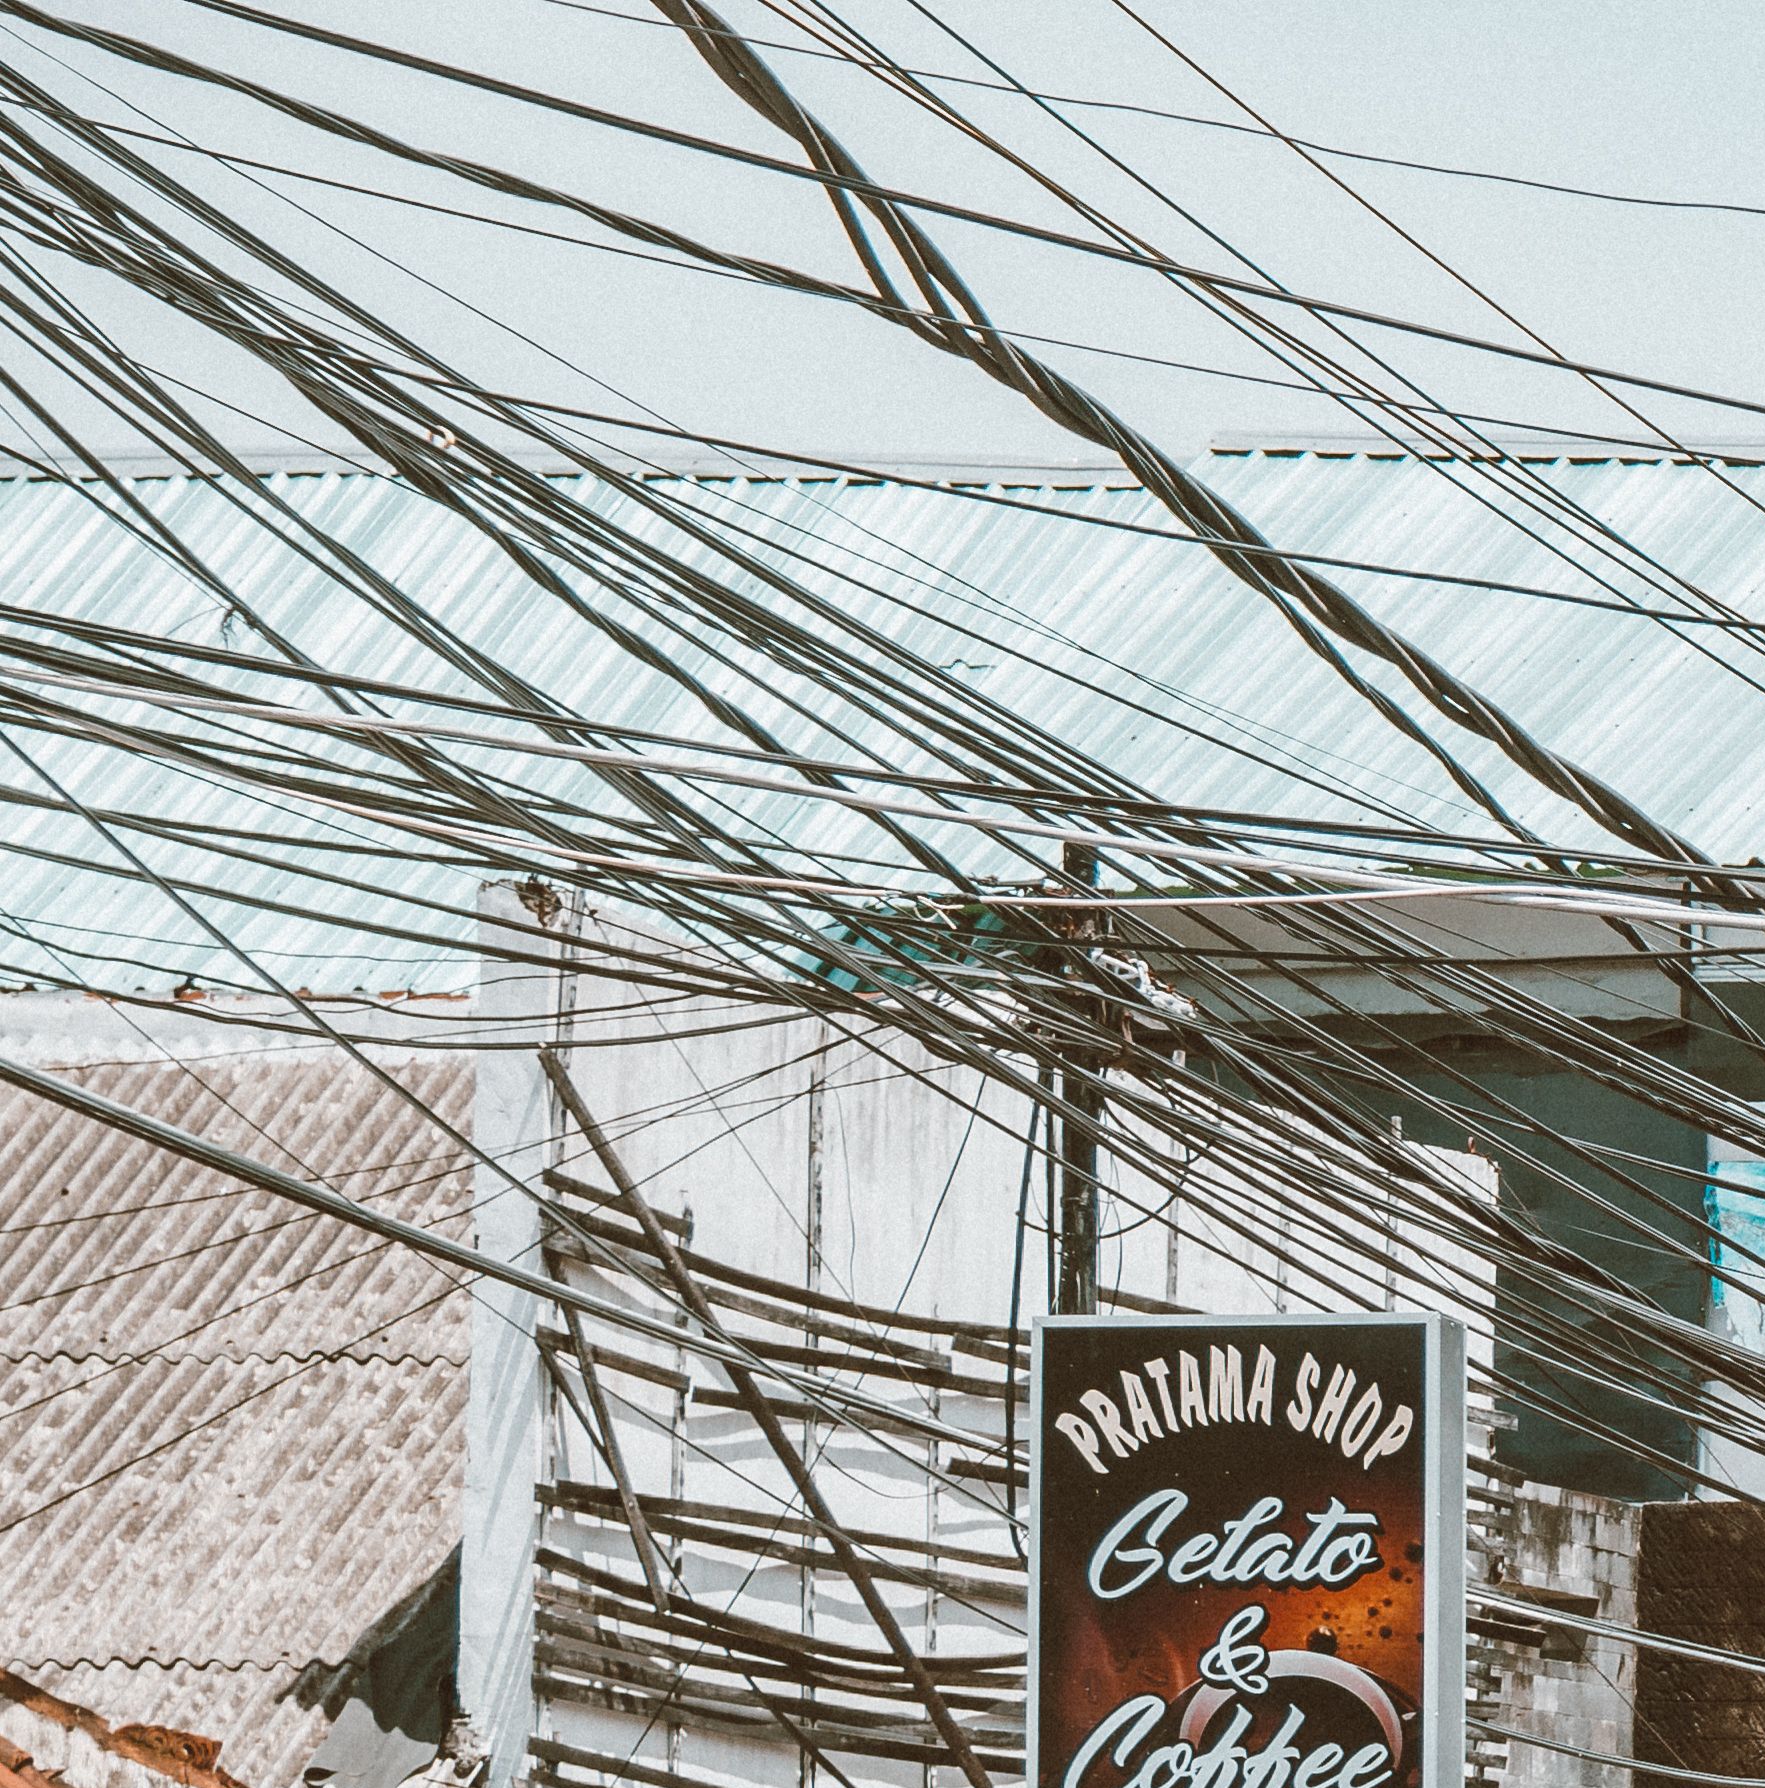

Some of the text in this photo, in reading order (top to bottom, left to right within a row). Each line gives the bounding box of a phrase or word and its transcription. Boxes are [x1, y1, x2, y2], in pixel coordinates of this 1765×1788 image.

[1055, 1344, 1414, 1473] PRATAMA SHOP
[1089, 1488, 1379, 1600] Gelato
[1200, 1606, 1270, 1694] &
